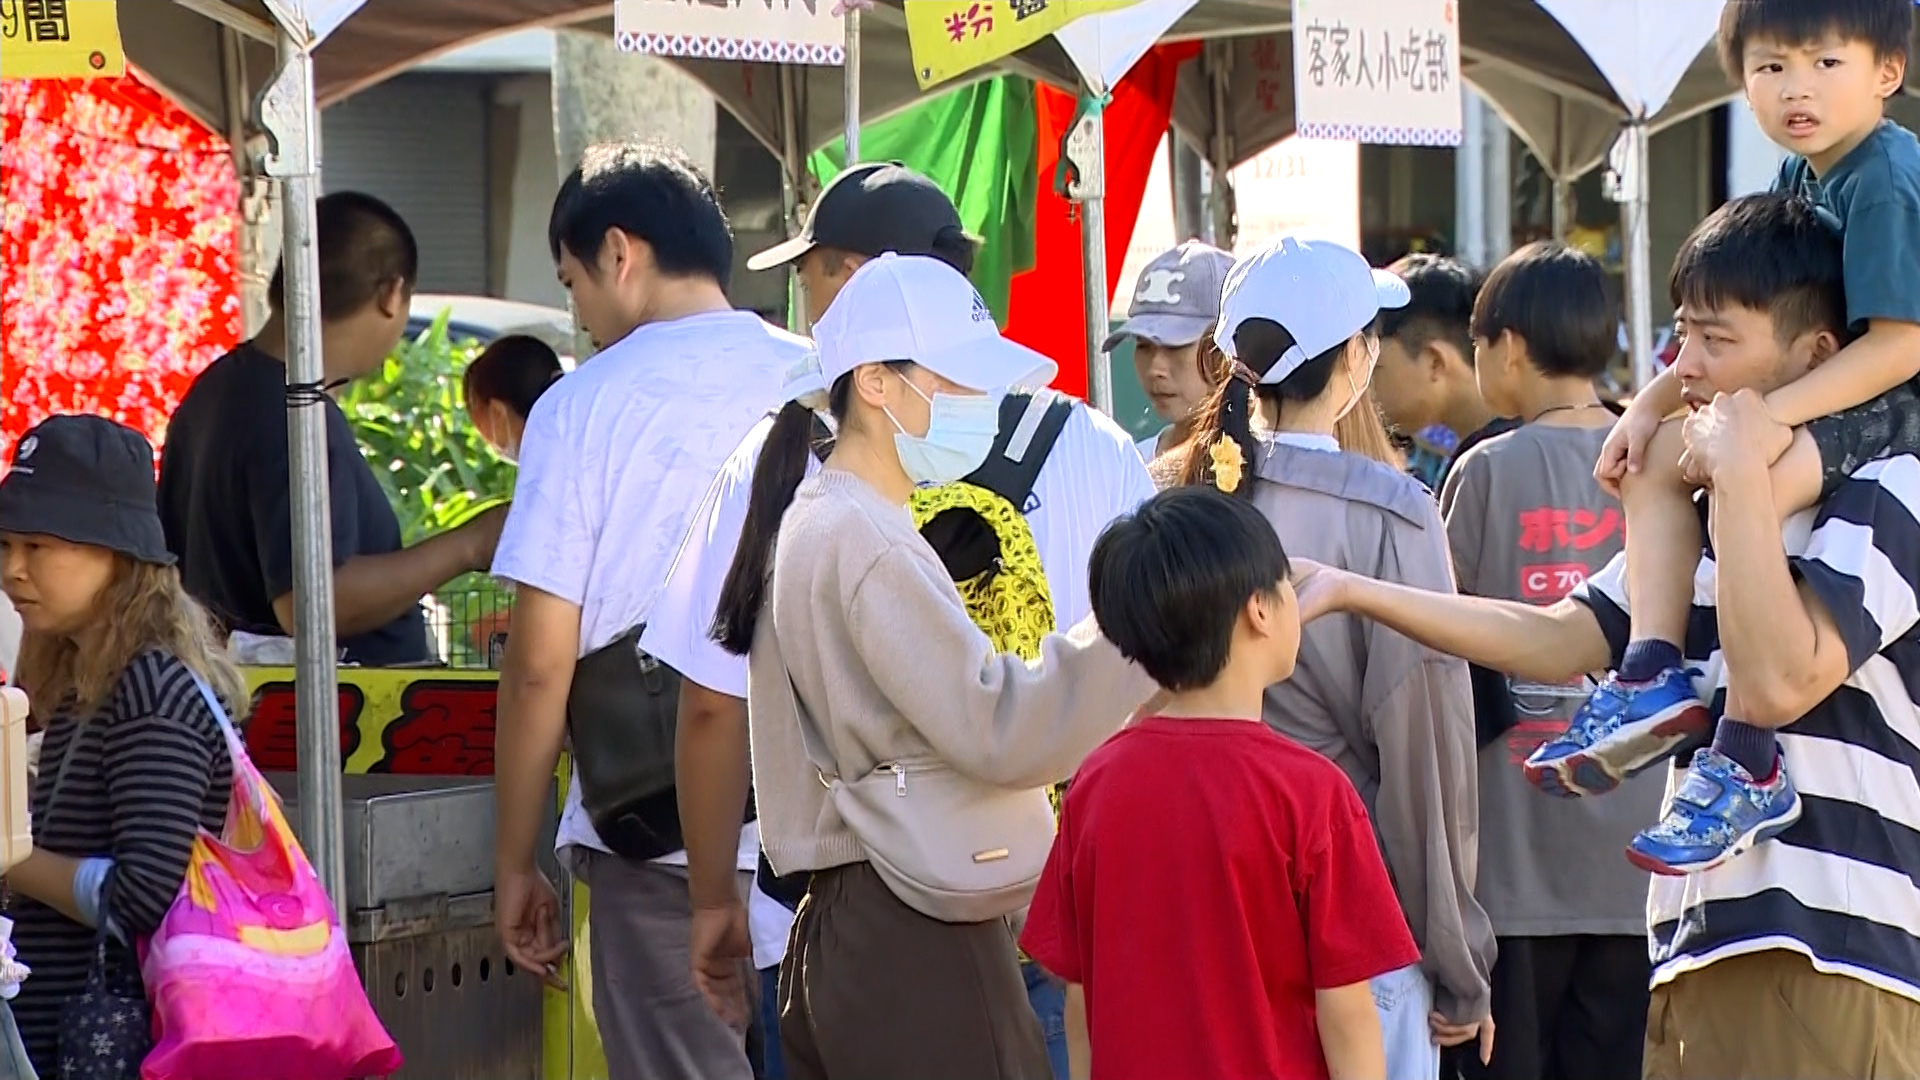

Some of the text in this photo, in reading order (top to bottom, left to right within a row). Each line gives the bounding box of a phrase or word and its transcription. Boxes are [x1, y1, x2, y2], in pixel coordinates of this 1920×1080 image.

[944, 2, 993, 43] 粉
[1305, 17, 1450, 93] 客家人小吃部
[1253, 154, 1307, 180] 12/31
[1519, 505, 1627, 552] ホン
